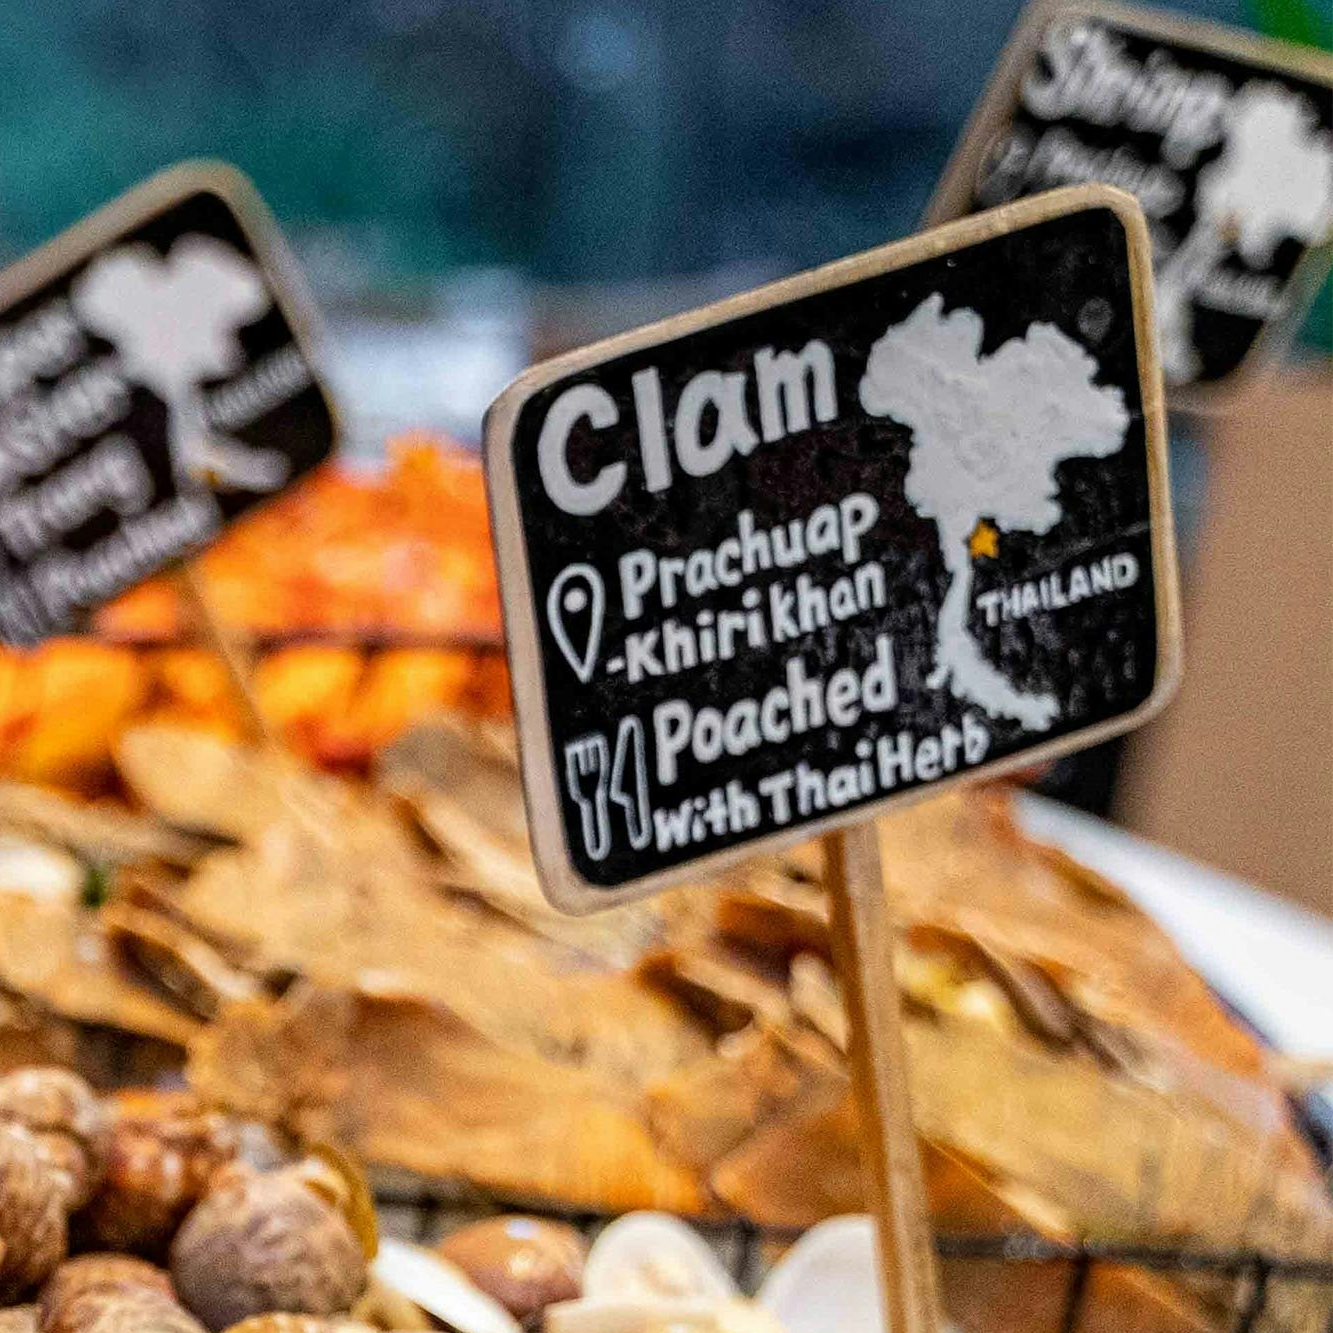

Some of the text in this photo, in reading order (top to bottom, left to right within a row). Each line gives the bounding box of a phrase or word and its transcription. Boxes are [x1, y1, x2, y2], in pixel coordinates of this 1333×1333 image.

[537, 340, 838, 516] Clam
[618, 492, 880, 621] Prachuap
[976, 552, 1140, 627] THAILAND
[653, 633, 897, 786] Poached
